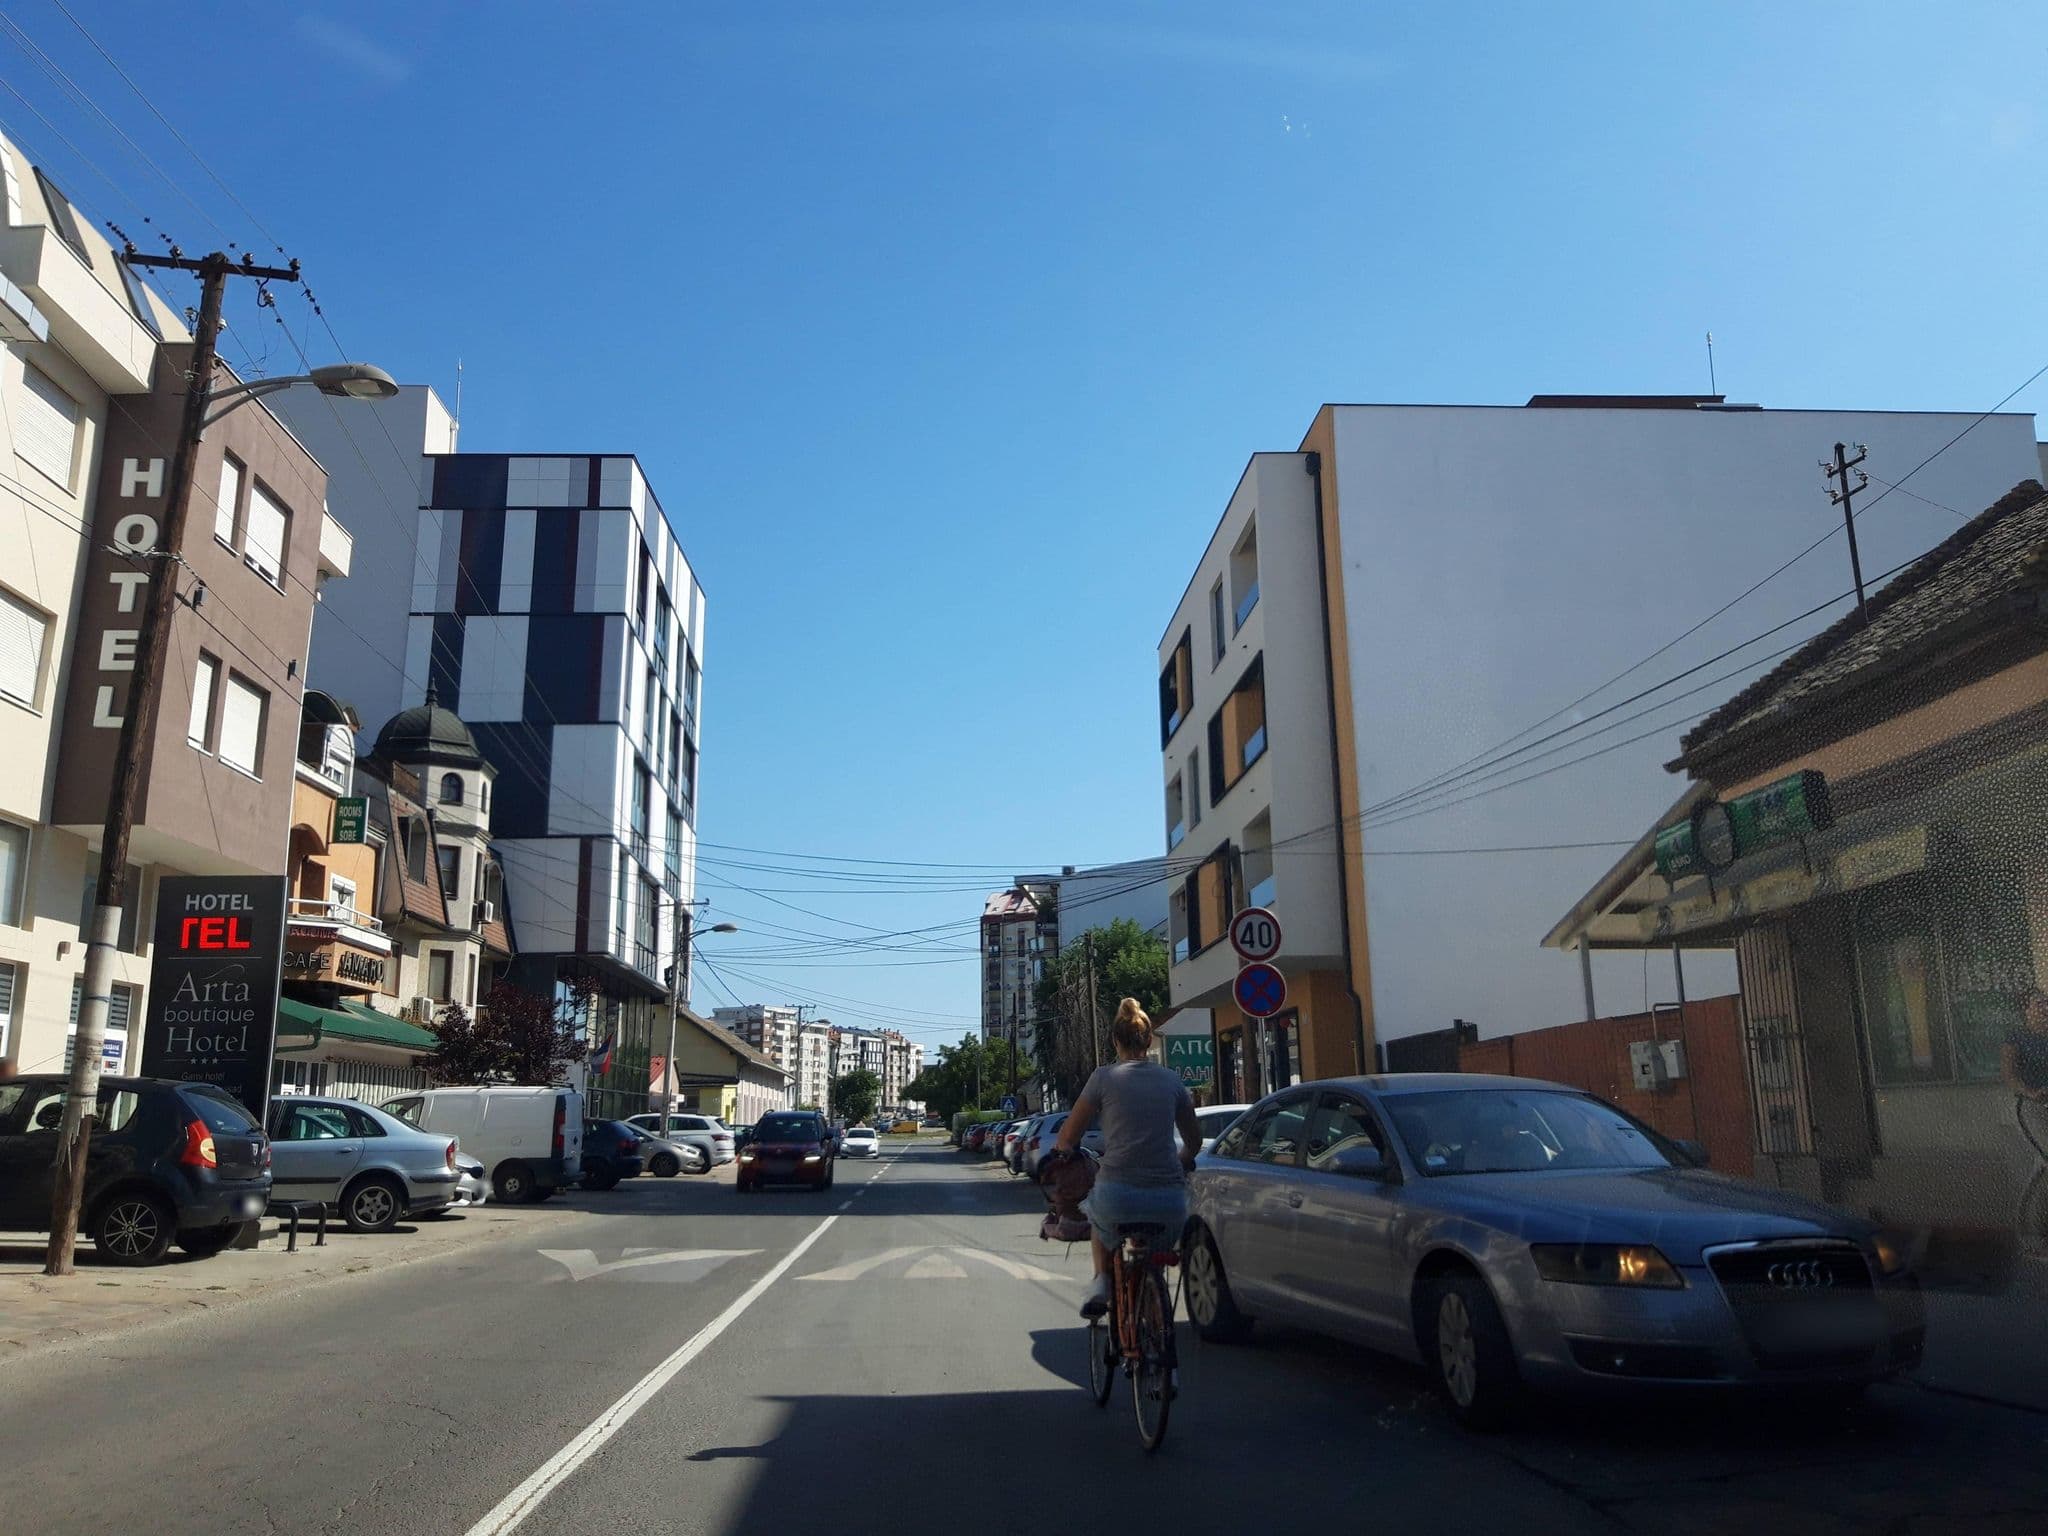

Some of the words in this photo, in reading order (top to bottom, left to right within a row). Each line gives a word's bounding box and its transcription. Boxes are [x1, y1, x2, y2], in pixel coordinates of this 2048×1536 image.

[93, 457, 165, 729] HOTEL
[338, 806, 362, 817] ROOMS
[338, 830, 357, 841] SOBE
[184, 893, 254, 911] HOTEL
[1240, 921, 1272, 949] 40
[283, 951, 332, 970] CAFE
[171, 966, 250, 1003] Arta
[163, 1006, 255, 1025] boutique
[165, 1025, 248, 1054] Hotel
